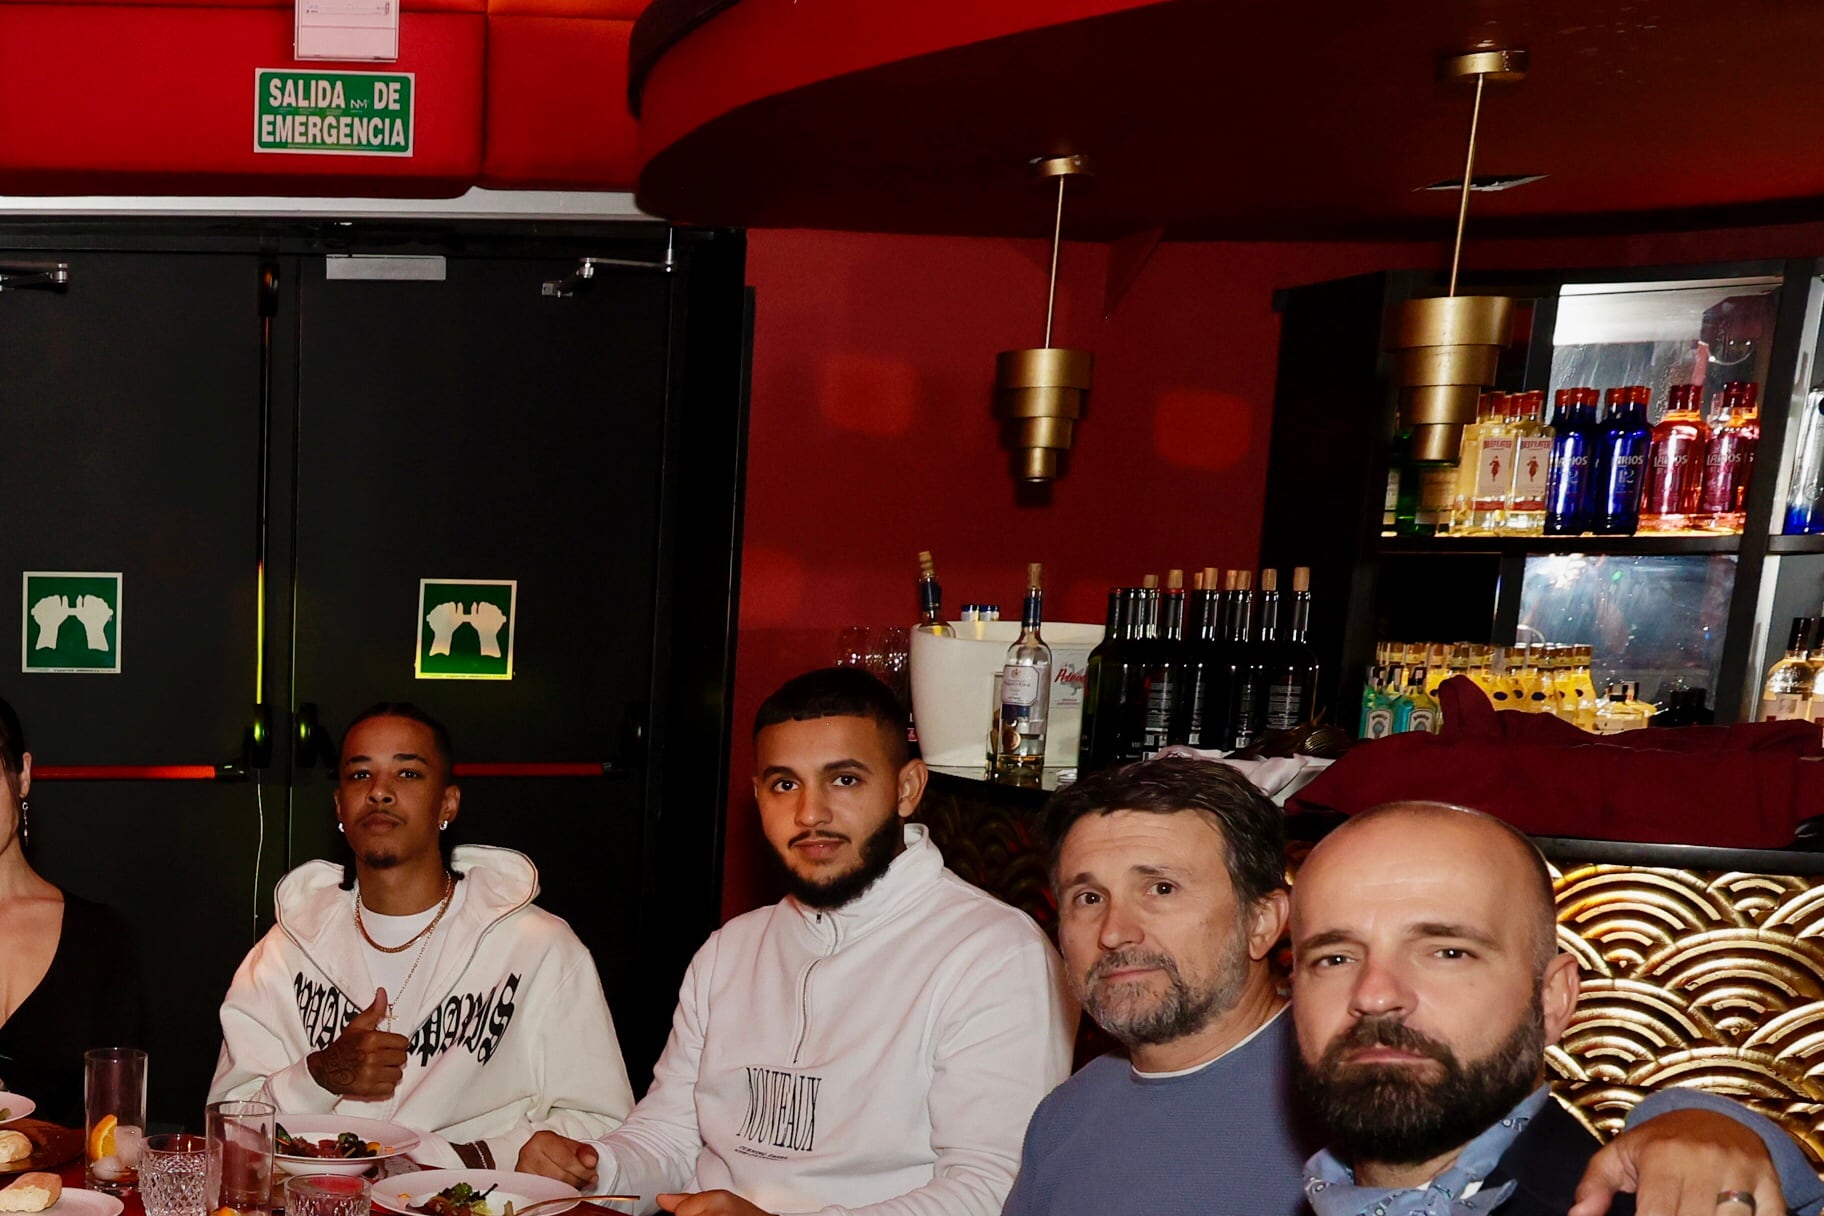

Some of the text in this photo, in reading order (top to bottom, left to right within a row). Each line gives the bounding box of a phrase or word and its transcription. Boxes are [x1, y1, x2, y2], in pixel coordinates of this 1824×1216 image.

[268, 77, 401, 111] SALIDA DE
[261, 114, 406, 146] EMERGENCIA
